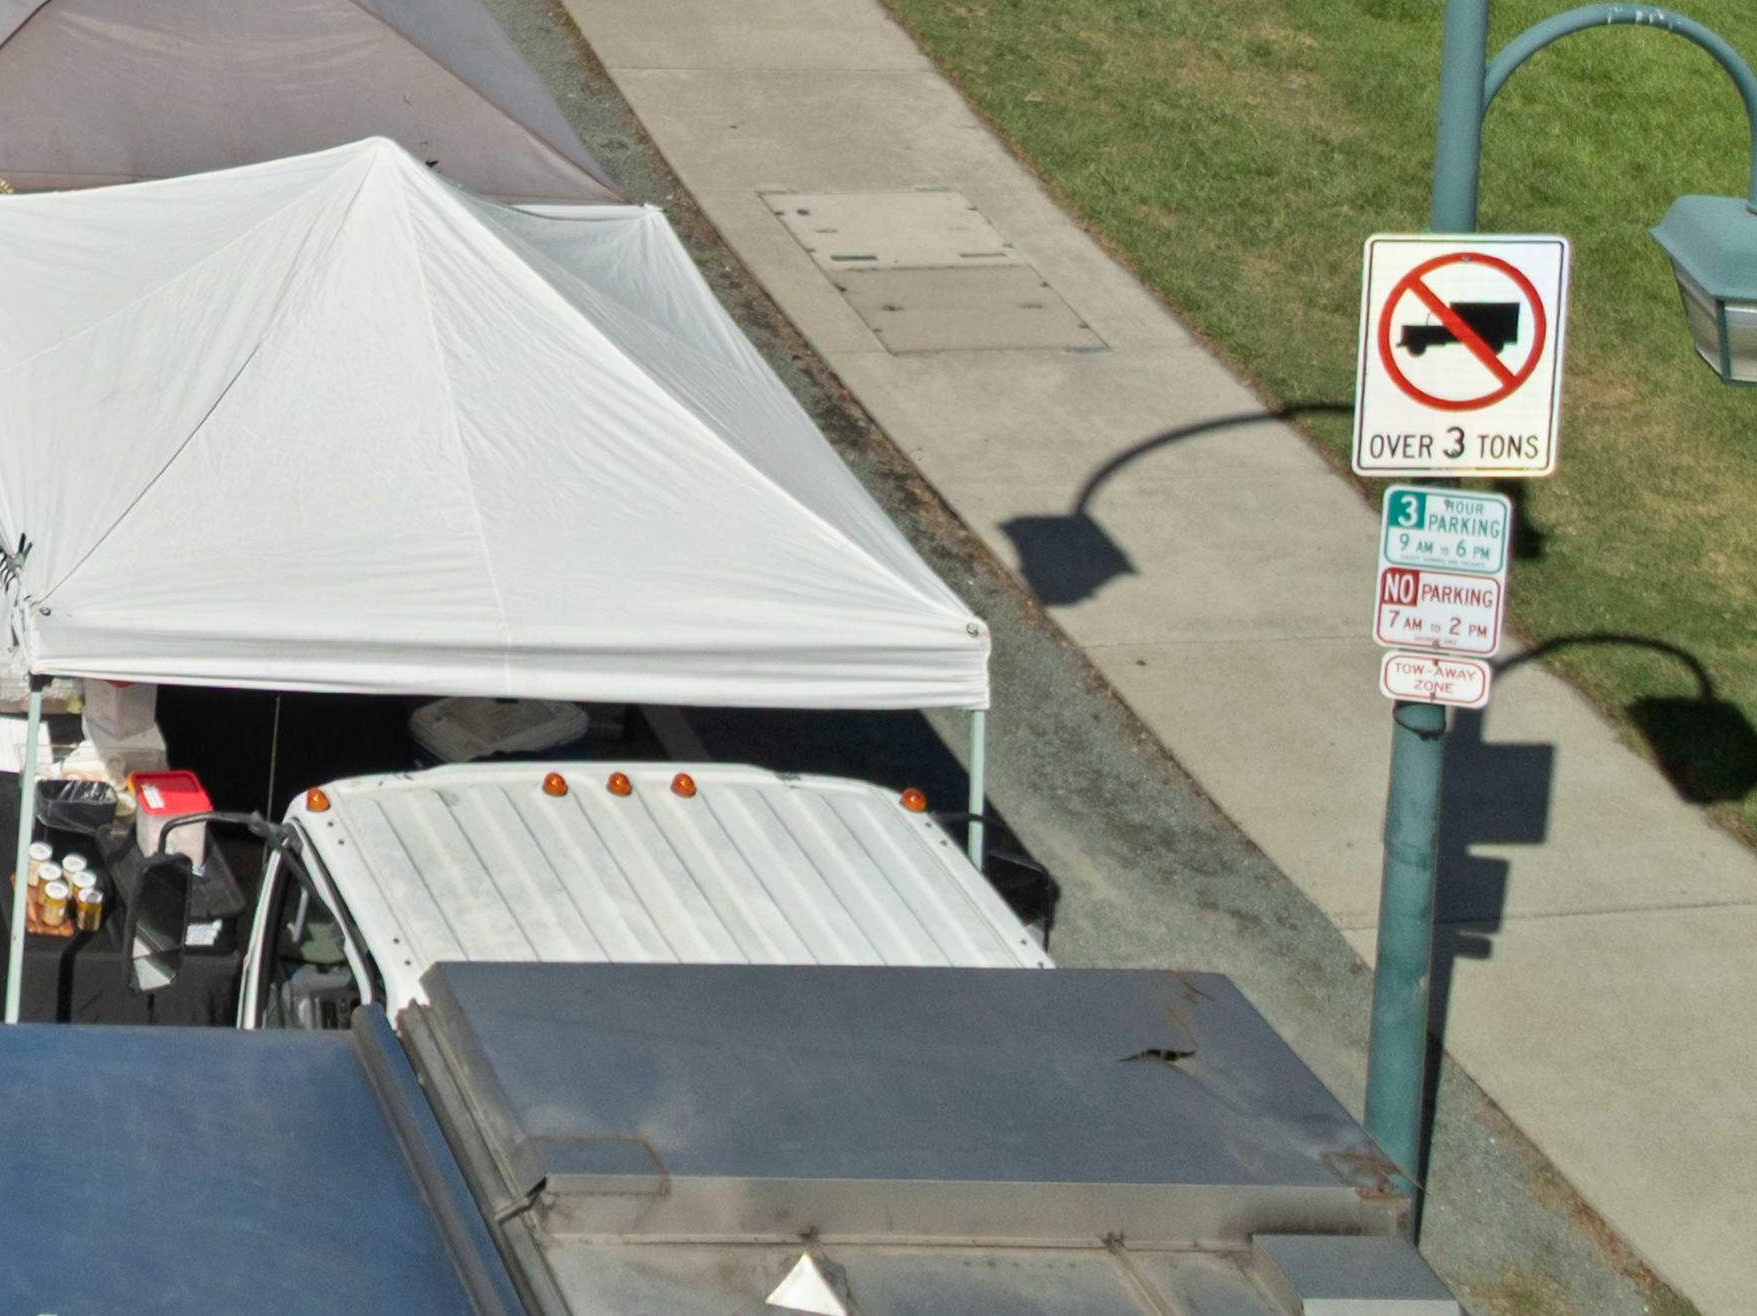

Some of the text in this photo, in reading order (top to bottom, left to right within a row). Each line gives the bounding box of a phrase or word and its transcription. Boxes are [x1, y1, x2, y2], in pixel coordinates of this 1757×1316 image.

[1369, 426, 1539, 460] OVER 3 TONS
[1397, 495, 1418, 527] 3
[1445, 499, 1484, 515] HOUR
[1428, 514, 1500, 539] PARKING
[1399, 533, 1410, 550] 9
[1416, 541, 1434, 554] AM
[1455, 539, 1466, 557] 6
[1473, 547, 1490, 560] PM
[1384, 572, 1494, 608] NO PARKING
[1389, 610, 1400, 628] 7
[1404, 618, 1422, 632] AM
[1449, 616, 1462, 636] 2
[1468, 624, 1487, 638] PM
[1395, 662, 1476, 680] TOW-AWAY
[1414, 680, 1454, 693] ZONE
